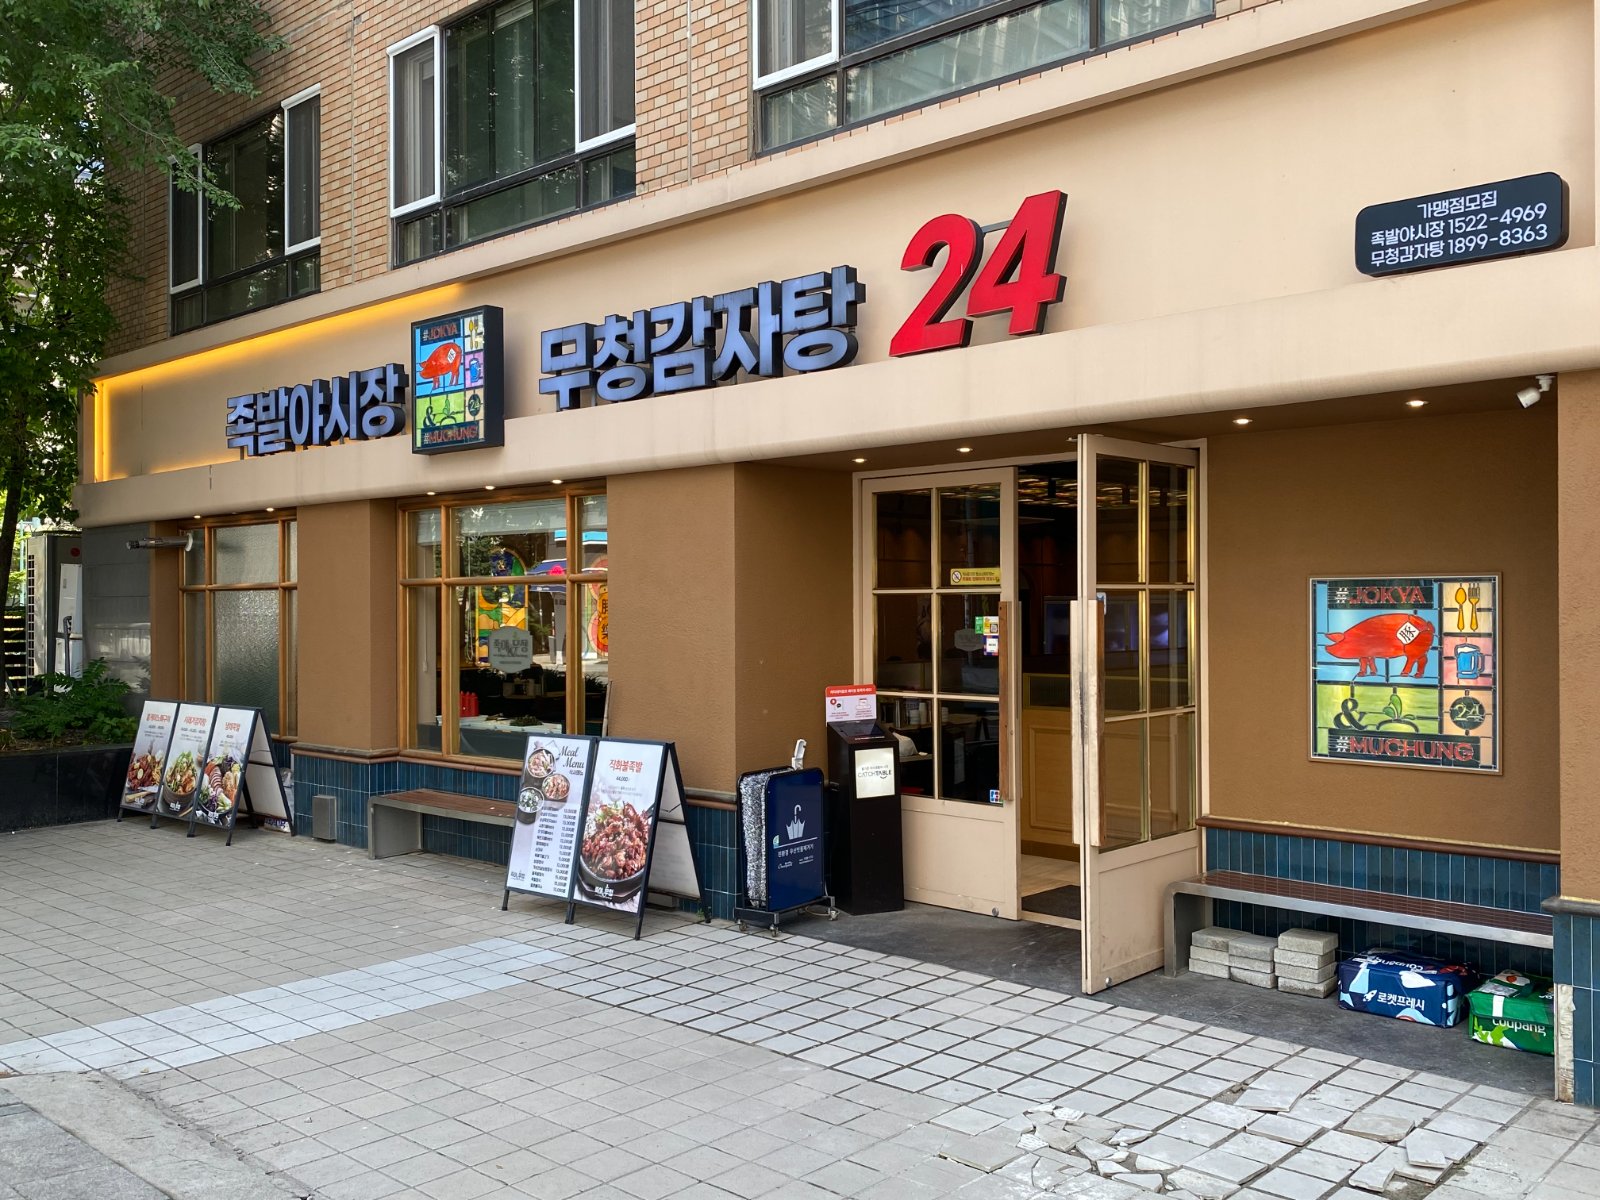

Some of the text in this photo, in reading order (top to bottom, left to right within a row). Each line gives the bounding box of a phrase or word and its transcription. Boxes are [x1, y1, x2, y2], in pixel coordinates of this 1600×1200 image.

[1417, 190, 1497, 219] 가맹점모집
[1371, 202, 1547, 247] 족발야시장 1522-4969
[1370, 223, 1548, 267] 무청감자탕 1899-8363
[538, 189, 1067, 410] 무청감자탕 24
[226, 363, 406, 457] 족발야시장
[1335, 585, 1426, 605] #JOKYA
[1453, 703, 1485, 722] 24
[558, 745, 579, 757] Meal
[1336, 735, 1475, 762] #MUCHUNG
[563, 757, 585, 769] Menu
[609, 759, 643, 773] 직화불족발
[1377, 992, 1425, 1011] 로켓프레시
